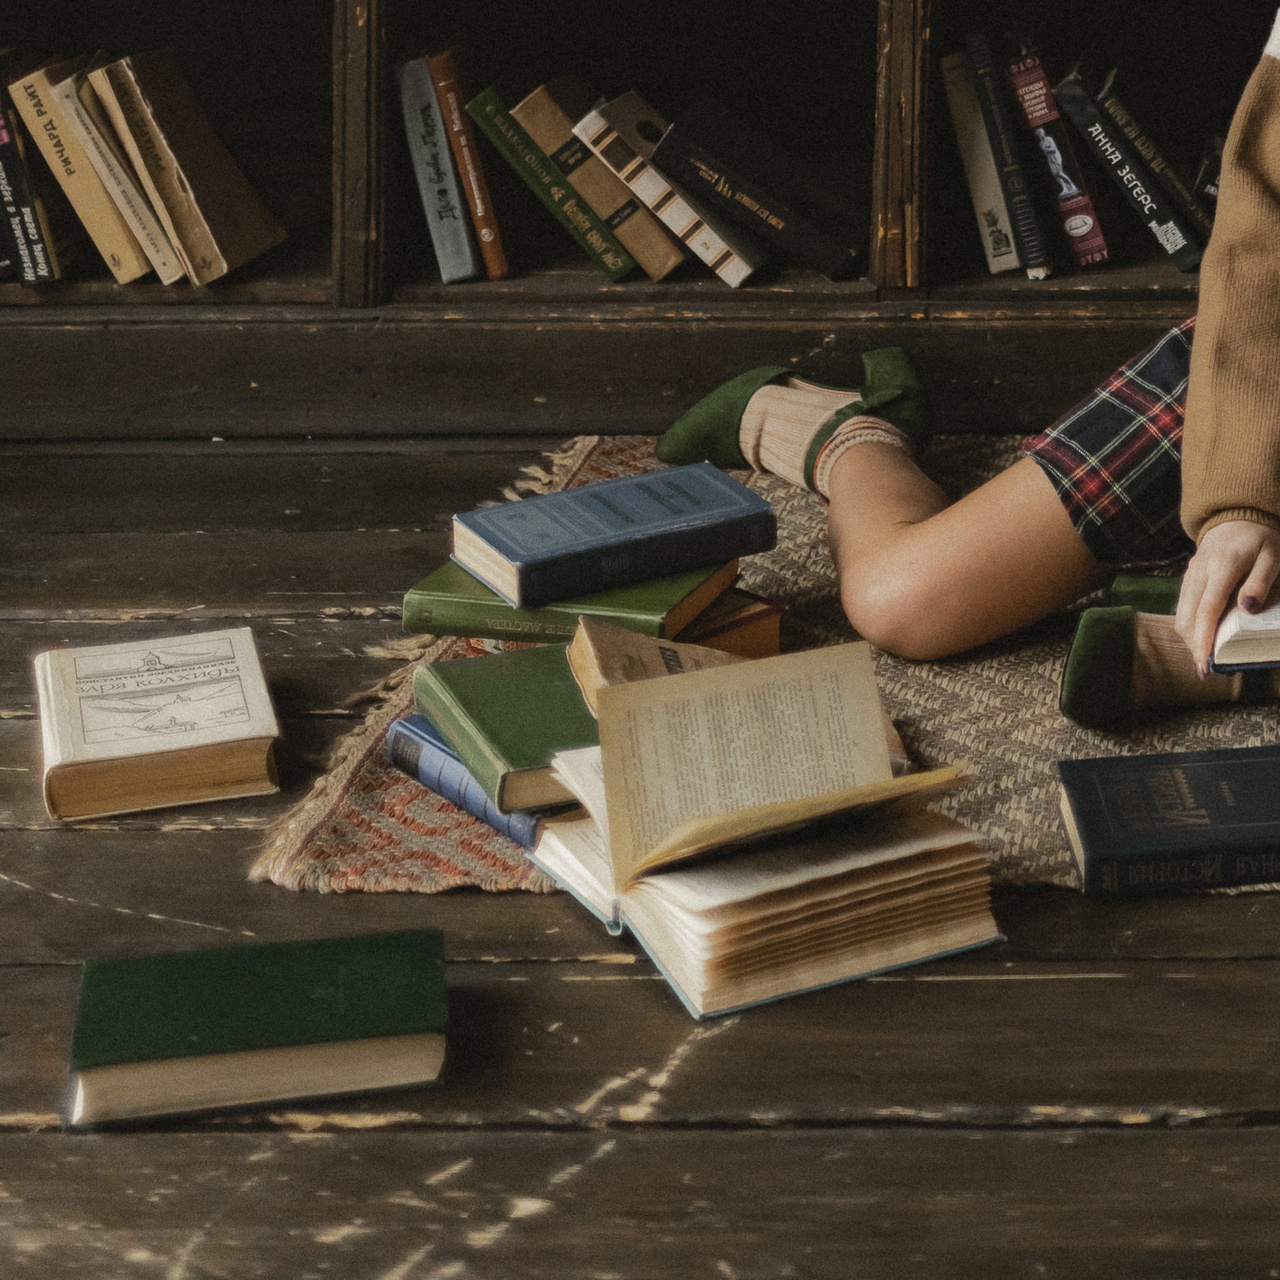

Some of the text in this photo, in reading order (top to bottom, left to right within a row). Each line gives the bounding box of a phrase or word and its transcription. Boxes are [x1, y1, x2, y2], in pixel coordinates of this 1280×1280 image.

[19, 80, 80, 177] РИЧАРД РАЙТ
[1084, 121, 1160, 216] АННА ЗЕГЕРС
[20, 204, 49, 277] Конец света
[1126, 856, 1222, 888] ИСТОРИЯ
